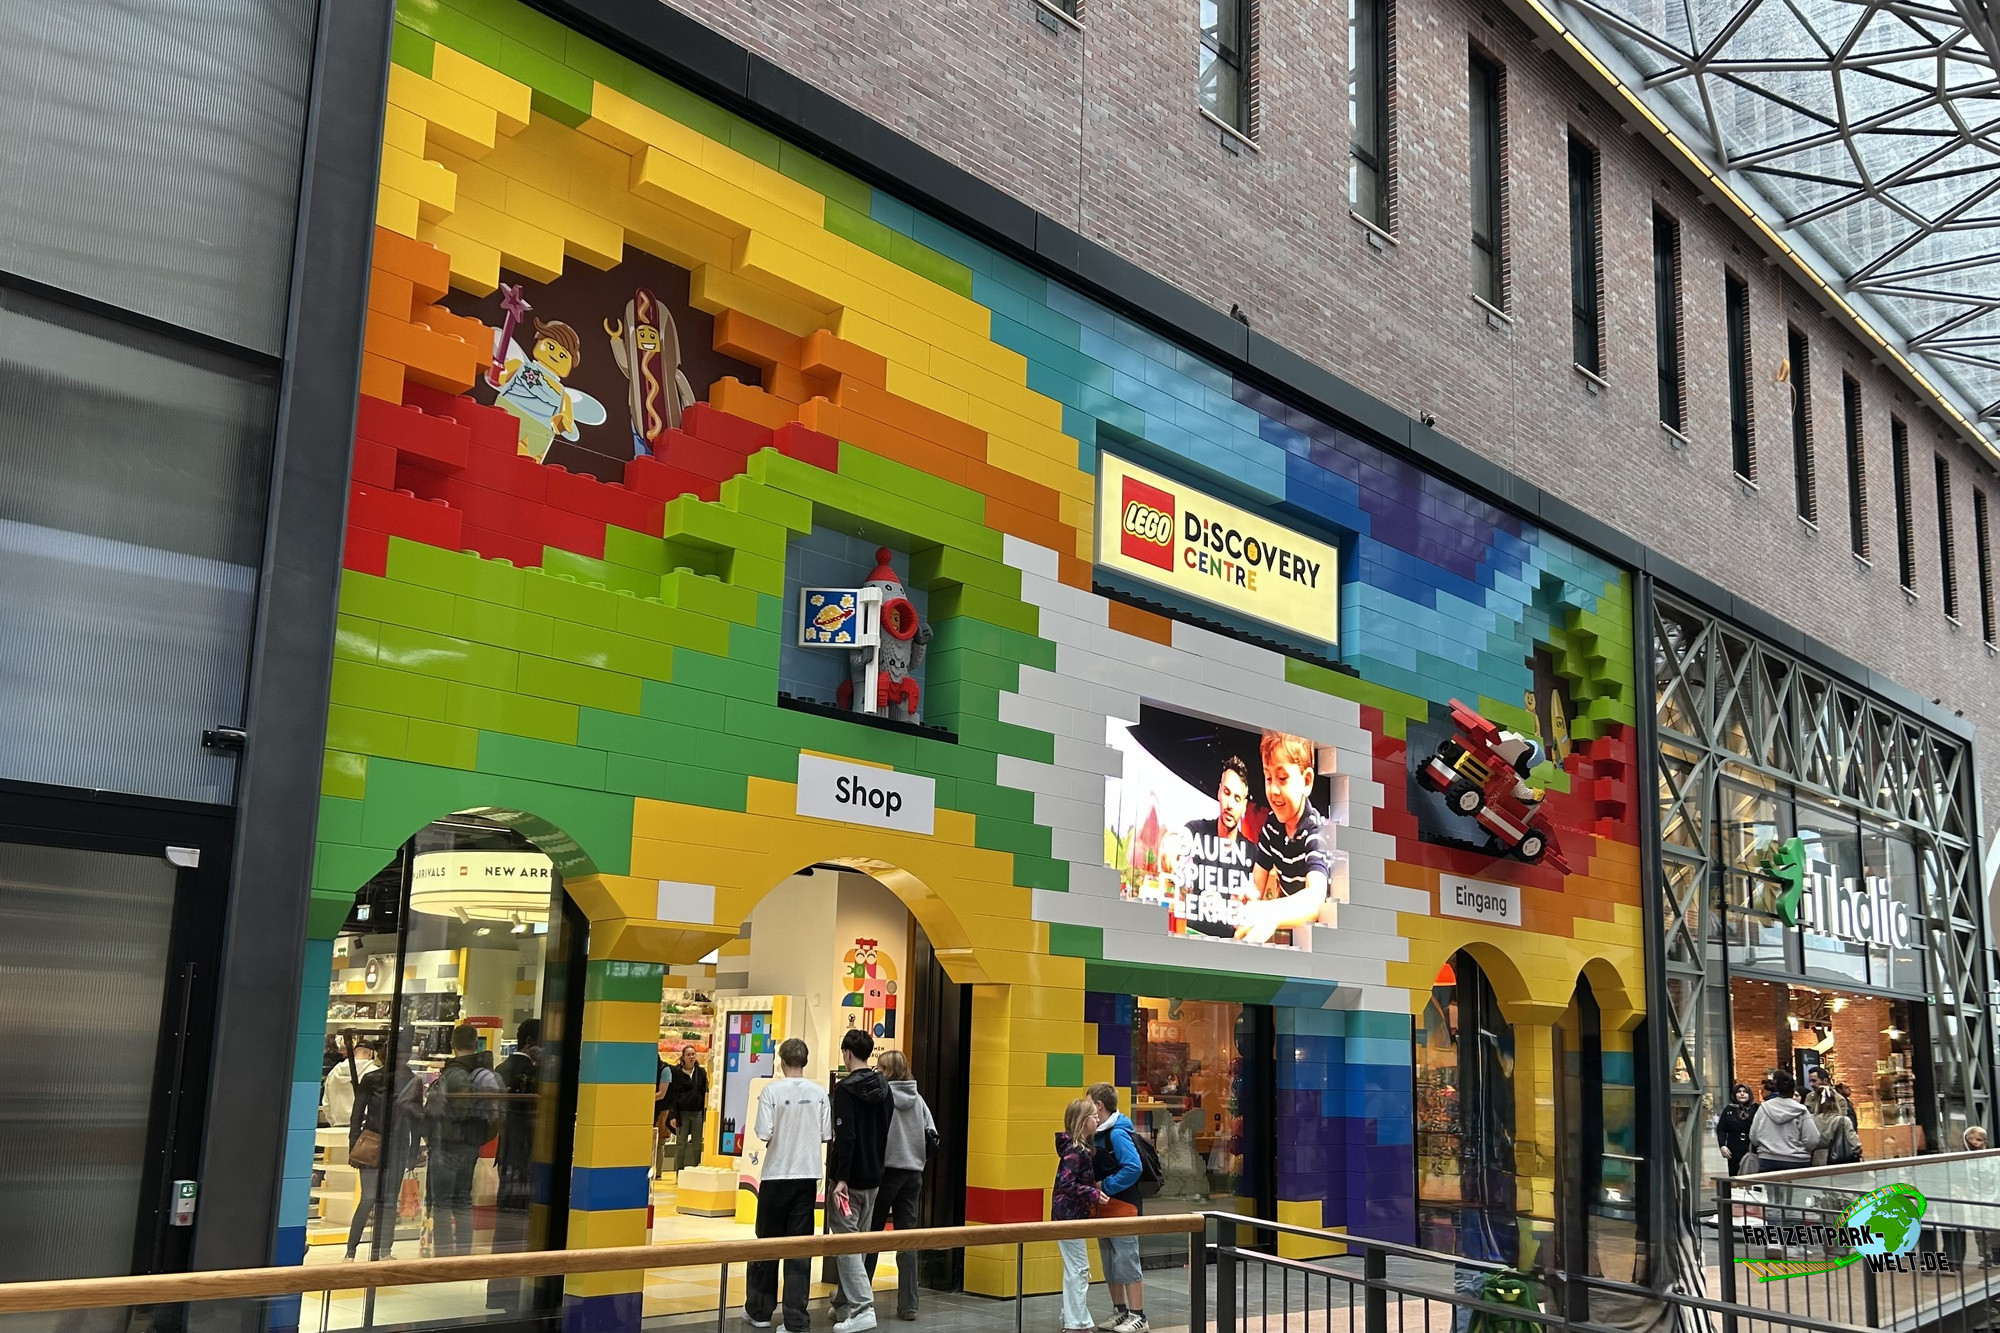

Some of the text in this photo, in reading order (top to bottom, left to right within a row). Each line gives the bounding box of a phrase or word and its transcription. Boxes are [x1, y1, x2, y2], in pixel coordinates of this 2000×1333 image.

[1125, 502, 1172, 545] LEGO
[1184, 546, 1257, 592] CENTRE
[835, 775, 902, 817] Shop
[415, 867, 446, 880] ARRIVALS
[485, 866, 553, 878] NEW ARRI
[1456, 884, 1507, 917] Eingang
[1806, 857, 1912, 949] Thalia
[1149, 1022, 1180, 1040] tre
